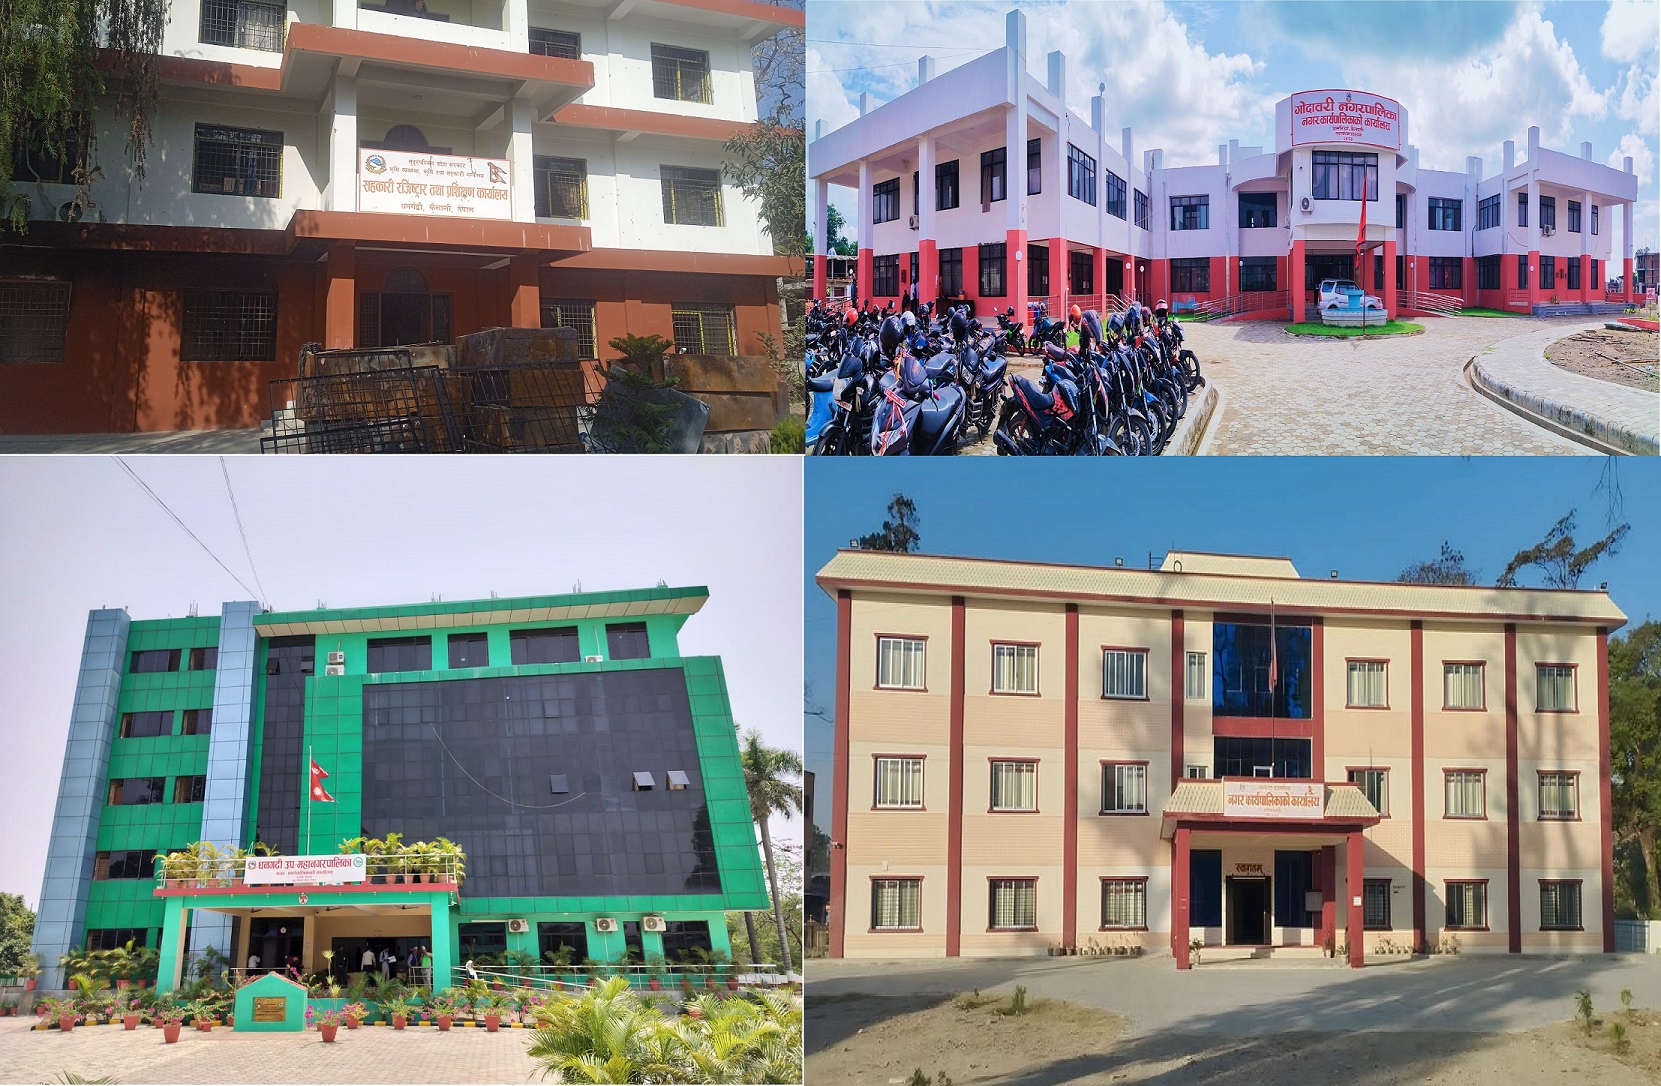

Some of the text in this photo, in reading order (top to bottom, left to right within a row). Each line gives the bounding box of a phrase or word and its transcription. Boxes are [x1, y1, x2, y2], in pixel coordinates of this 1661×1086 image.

[1294, 97, 1397, 121] गोदावरी नगरपालिका
[1301, 115, 1320, 126] नगर
[1320, 112, 1363, 125] कार्यपालिकाको
[1364, 117, 1391, 131] कार्यालय
[363, 178, 394, 193] सहकारी
[430, 184, 444, 197] तथा
[446, 181, 474, 199] प्रशिक्षण
[477, 185, 508, 200] कार्यालय
[1227, 794, 1245, 806] नगर
[1291, 792, 1320, 807] कार्यालय
[258, 859, 283, 870] धनगढी
